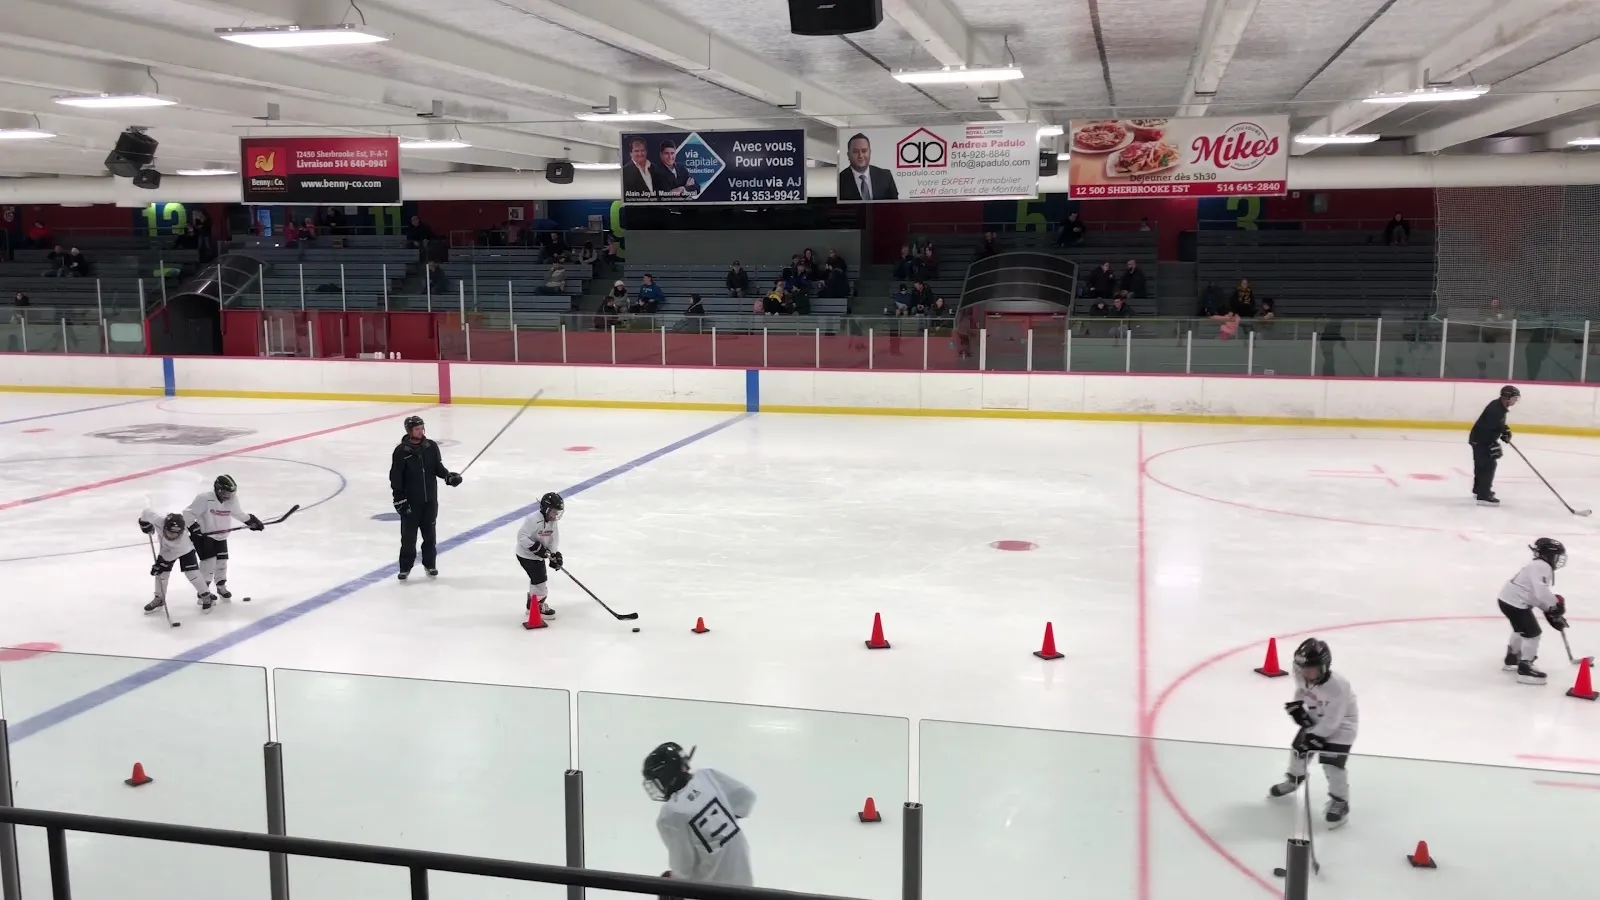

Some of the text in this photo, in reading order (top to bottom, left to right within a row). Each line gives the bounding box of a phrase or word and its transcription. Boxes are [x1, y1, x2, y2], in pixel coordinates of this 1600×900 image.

[732, 141, 796, 153] Avec vous,
[991, 139, 1026, 148] Padulo
[317, 150, 354, 158] Sherbrooke
[685, 149, 699, 158] via
[901, 142, 944, 168] ap
[951, 150, 1010, 159] 514-928-8846
[1190, 132, 1279, 168] Mikes
[297, 160, 333, 168] Livraison
[685, 158, 718, 167] capitale
[735, 156, 794, 167] Pour vous
[951, 159, 1031, 169] info@apadulo.com
[728, 176, 802, 188] Vendu via AJ
[941, 177, 975, 186] EXPERT
[1130, 174, 1173, 184] Déjeuner
[1193, 172, 1217, 180] 5h30
[301, 179, 382, 190] www.benny-co.com
[1076, 184, 1191, 195] 12 500 SHERBROOKE EST
[1217, 182, 1281, 192] 514 645-2840
[730, 189, 800, 201] 514 353-9942
[939, 187, 958, 195] dans
[992, 185, 1029, 193] Montréal
